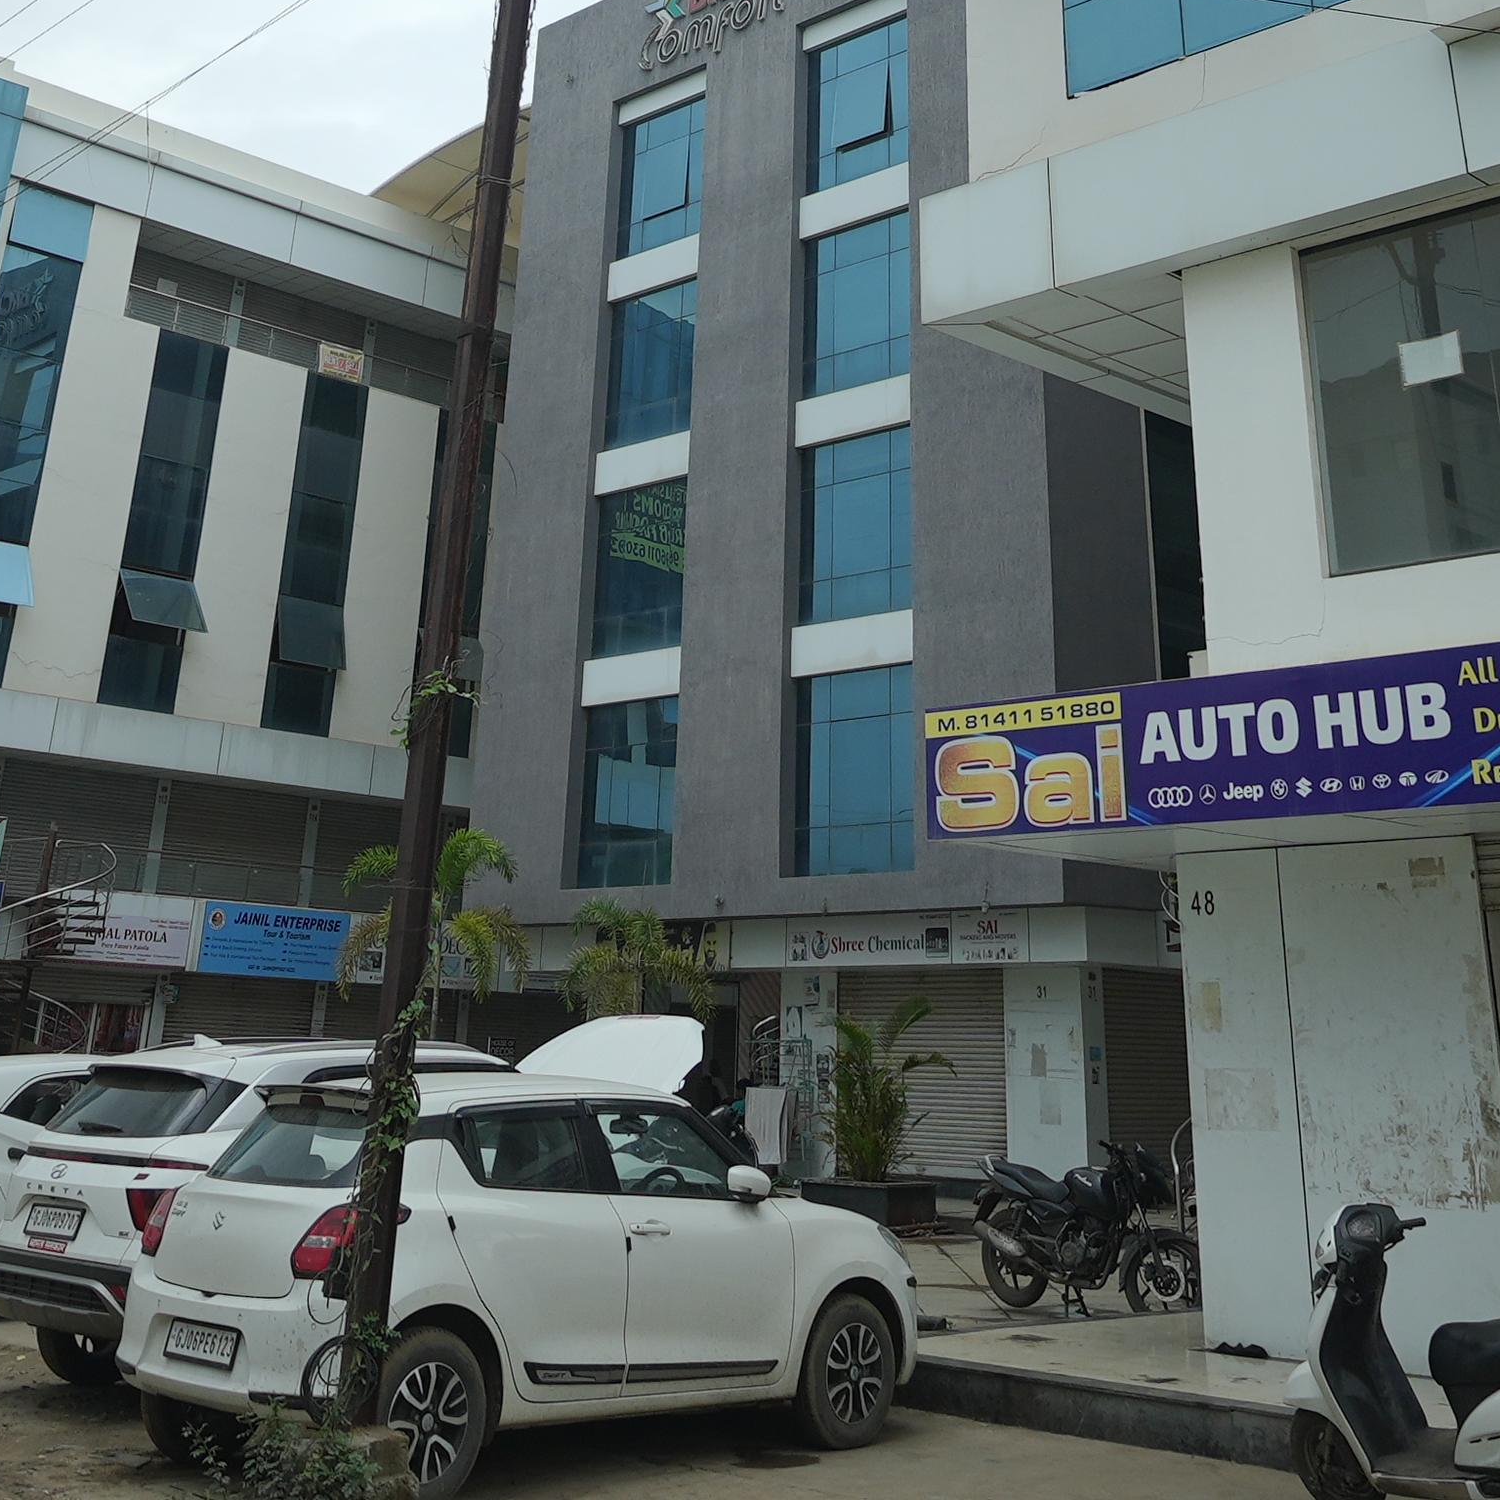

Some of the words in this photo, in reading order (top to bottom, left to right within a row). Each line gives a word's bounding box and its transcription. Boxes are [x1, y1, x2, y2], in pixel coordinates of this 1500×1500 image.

[1457, 656, 1499, 687] All
[937, 717, 961, 733] M.
[965, 709, 1033, 730] 81411
[1040, 700, 1115, 722] 51880
[1139, 698, 1300, 765] AUTO
[1313, 681, 1452, 751] HUB
[934, 723, 1127, 833] Sai
[1222, 781, 1264, 802] Jeep
[1191, 890, 1214, 916] 48
[234, 912, 270, 927] JAINIL
[273, 915, 342, 933] ENTERPRISE
[978, 920, 997, 934] SAI
[123, 928, 167, 943] PATOLA
[263, 929, 278, 938] Tour
[831, 936, 864, 954] Shree
[868, 934, 924, 953] Chemical
[1036, 985, 1047, 998] 31
[27, 1182, 83, 1196] CRETA
[175, 1327, 234, 1357] GJ06PE6123
